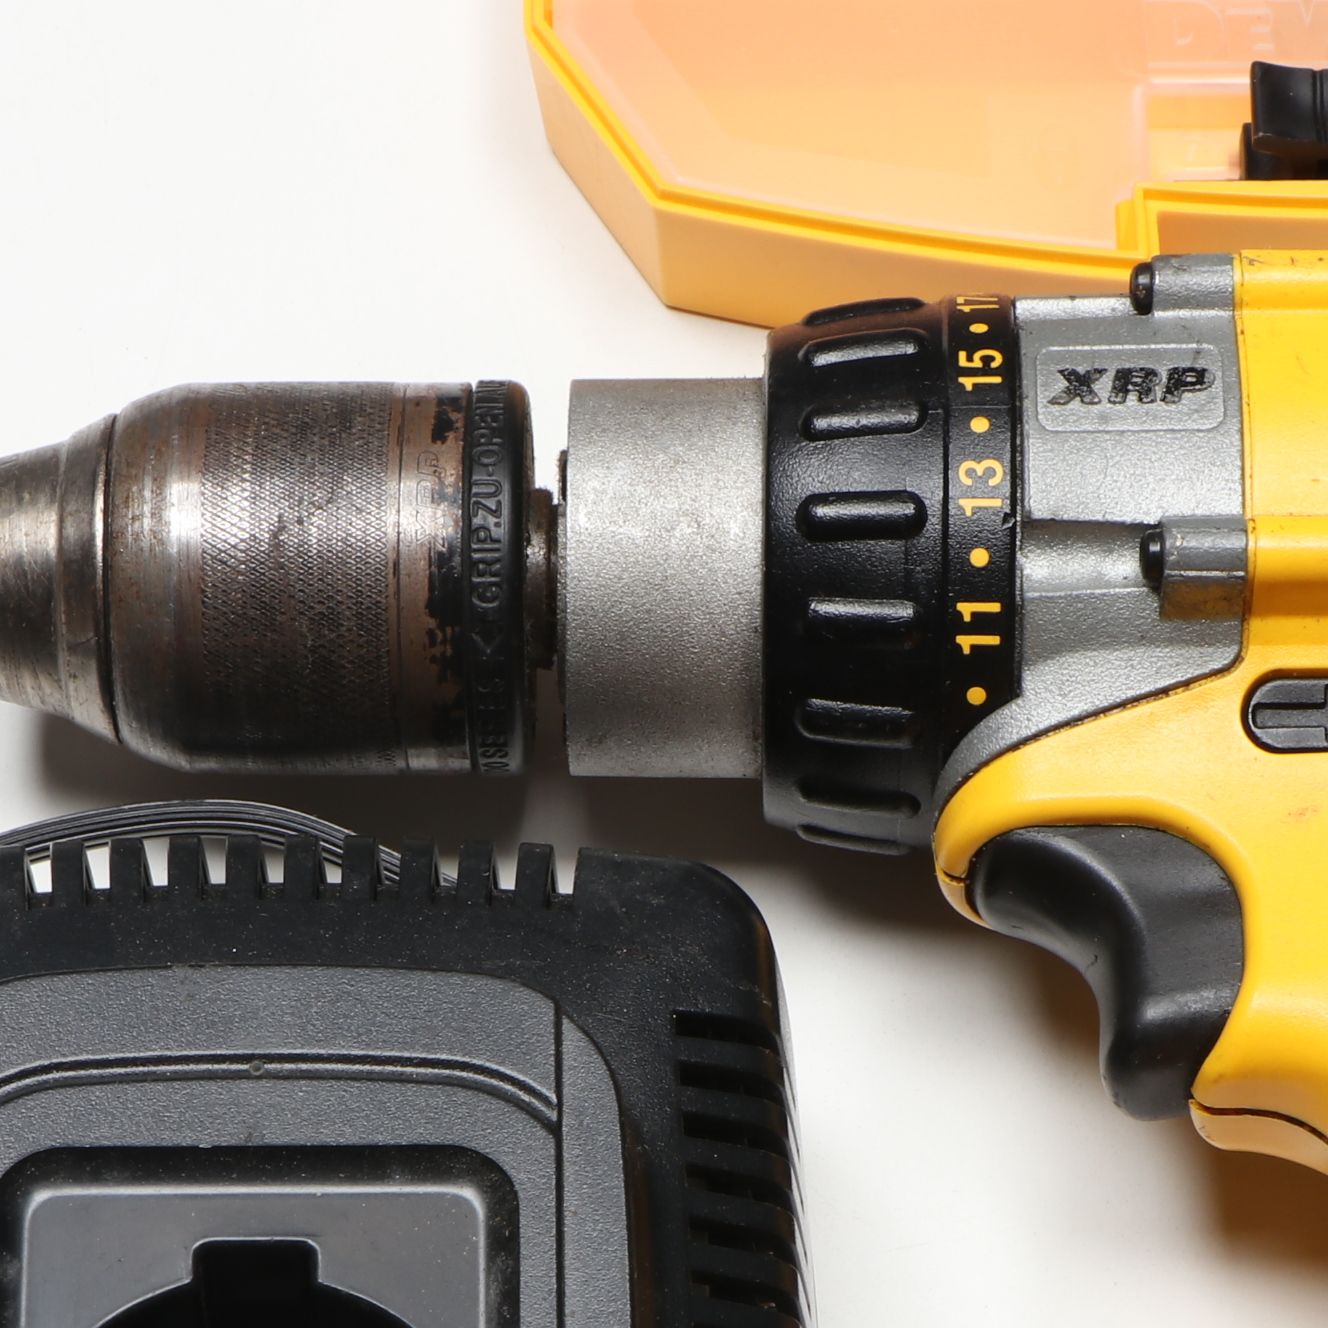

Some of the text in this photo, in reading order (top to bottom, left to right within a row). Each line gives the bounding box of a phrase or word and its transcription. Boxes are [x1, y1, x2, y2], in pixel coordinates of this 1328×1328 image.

[958, 348, 1003, 391] 15
[1047, 366, 1215, 405] XRP
[958, 458, 1004, 516] 13
[956, 602, 1002, 654] 11
